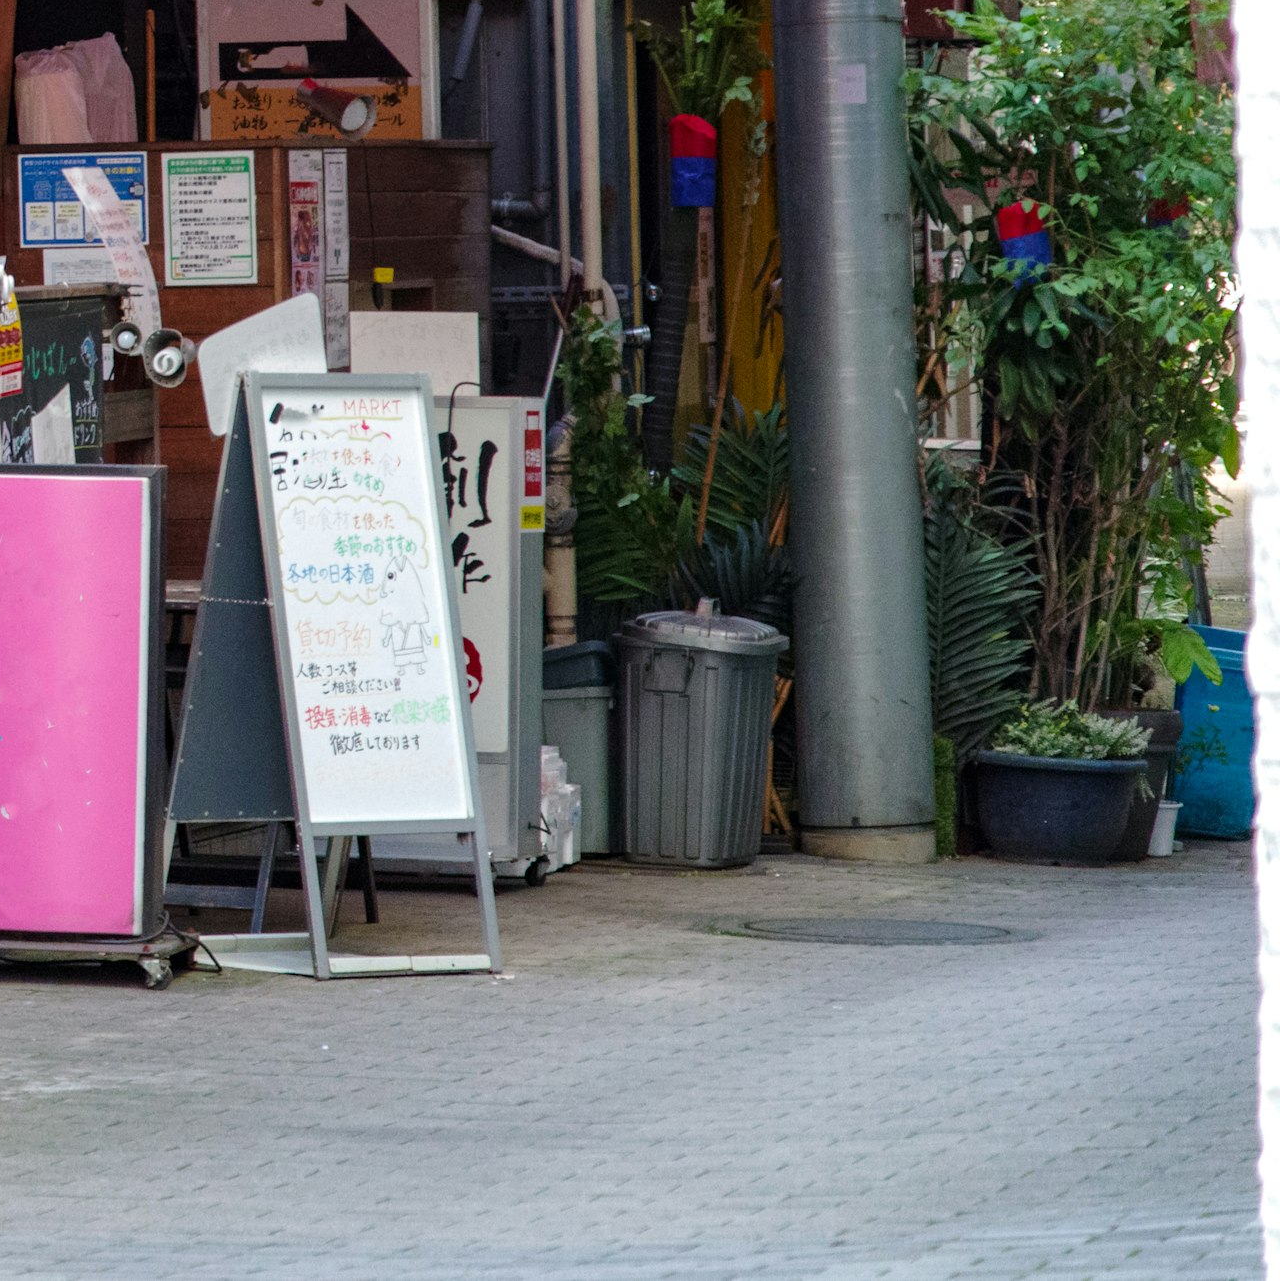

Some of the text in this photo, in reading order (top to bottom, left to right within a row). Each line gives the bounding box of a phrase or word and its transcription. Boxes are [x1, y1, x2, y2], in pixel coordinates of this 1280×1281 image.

[343, 398, 403, 416] MARKT
[333, 534, 418, 559] 季節のおすすめ
[287, 563, 375, 585] 各地の日本酒
[329, 731, 421, 756] 徹底しております
